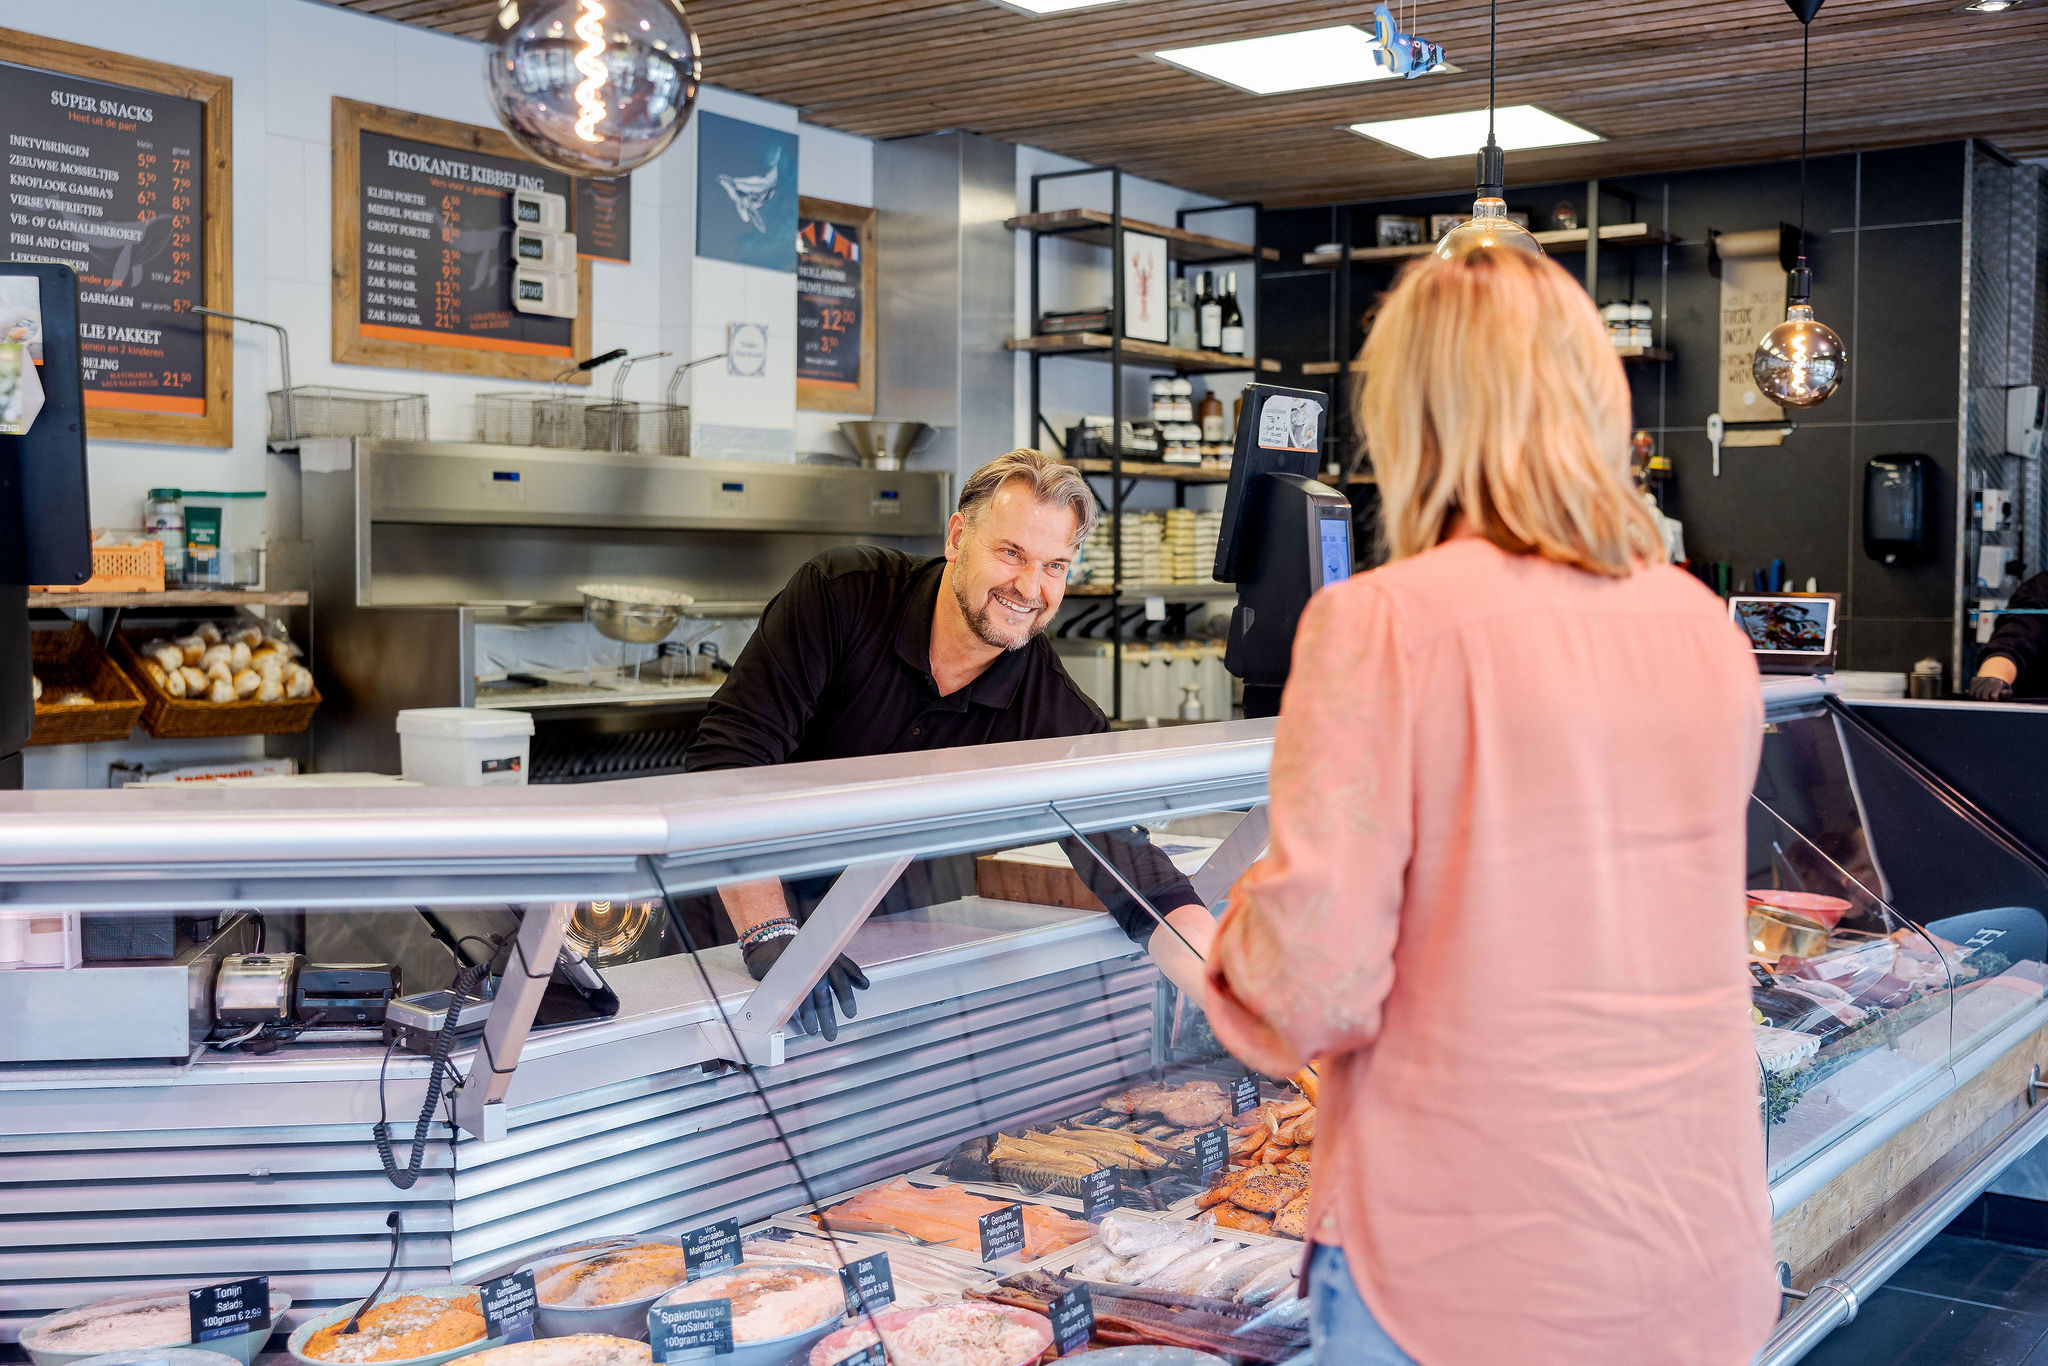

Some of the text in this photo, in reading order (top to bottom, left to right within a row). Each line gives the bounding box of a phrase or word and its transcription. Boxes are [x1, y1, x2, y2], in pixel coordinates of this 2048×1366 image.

[51, 90, 153, 123] SUPER SNACKS
[68, 111, 90, 124] Heet
[92, 117, 103, 127] uit
[105, 118, 116, 129] de
[9, 134, 90, 158] INKTVISRINGEN
[9, 154, 60, 173] ZEEUWSE
[60, 162, 120, 182] MOSSELTJES
[387, 149, 545, 191] KROKANTE KIBBELING
[9, 173, 68, 193] KNOFLOOK
[68, 182, 114, 200] GAMBA'S
[9, 193, 44, 209] VERSE
[44, 197, 104, 218] VISFRIETJES
[9, 212, 30, 226] VIS-
[31, 215, 47, 228] OF
[47, 218, 144, 242] GARNALENKROKET
[366, 220, 399, 235] GROOT
[9, 231, 34, 246] FISH
[36, 236, 59, 250] AND
[60, 239, 90, 254] CHIPS
[367, 242, 387, 256] ZAK
[367, 258, 387, 272] ZAK
[79, 274, 102, 285] onder
[367, 275, 387, 289] ZAK
[80, 291, 134, 308] GARNALEN
[367, 291, 387, 305] ZAK
[367, 308, 387, 321] ZAK
[107, 325, 162, 345] PAKKET
[107, 345, 119, 354] en
[120, 344, 127, 355] 2
[127, 346, 165, 358] kinderen
[81, 356, 120, 371] BELING
[82, 368, 98, 381] AT
[991, 1211, 1013, 1226] Gerookte
[698, 1230, 725, 1244] Gemaakte
[704, 1226, 716, 1234] Vers
[689, 1235, 738, 1256] Makreel-American
[988, 1235, 1007, 1247] 100gram
[858, 1261, 873, 1274] Zalm
[502, 1278, 514, 1287] Vers
[859, 1274, 876, 1287] Salade
[214, 1285, 242, 1299] Tonijn
[496, 1283, 521, 1298] Gemaakte
[216, 1300, 244, 1312] Salade
[488, 1288, 534, 1312] Makreel-American
[490, 1296, 535, 1322] Pittig (met sambal)
[661, 1307, 725, 1324] Spakenburgse
[203, 1314, 237, 1328] 100gram
[238, 1311, 244, 1321] €
[672, 1321, 714, 1335] TopSalade
[664, 1335, 698, 1347] 100gram
[700, 1332, 706, 1343] €
